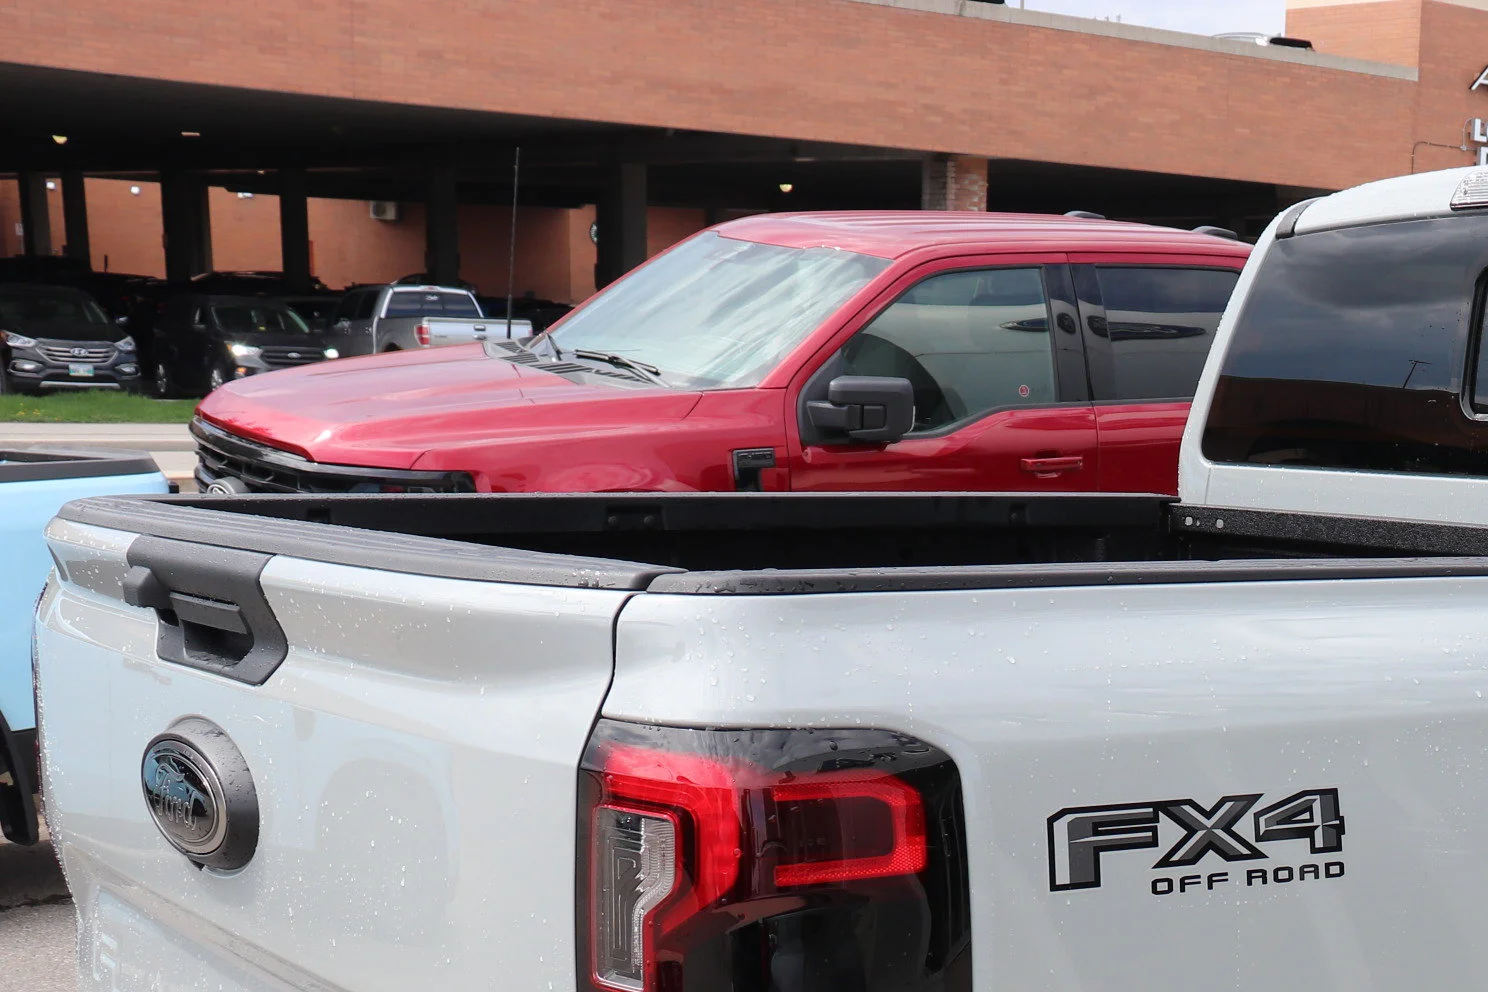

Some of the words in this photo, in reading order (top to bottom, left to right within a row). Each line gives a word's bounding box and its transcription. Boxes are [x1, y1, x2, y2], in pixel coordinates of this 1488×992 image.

[1047, 787, 1346, 892] FX4
[1151, 871, 1229, 895] OFF
[1246, 861, 1345, 886] ROAD
